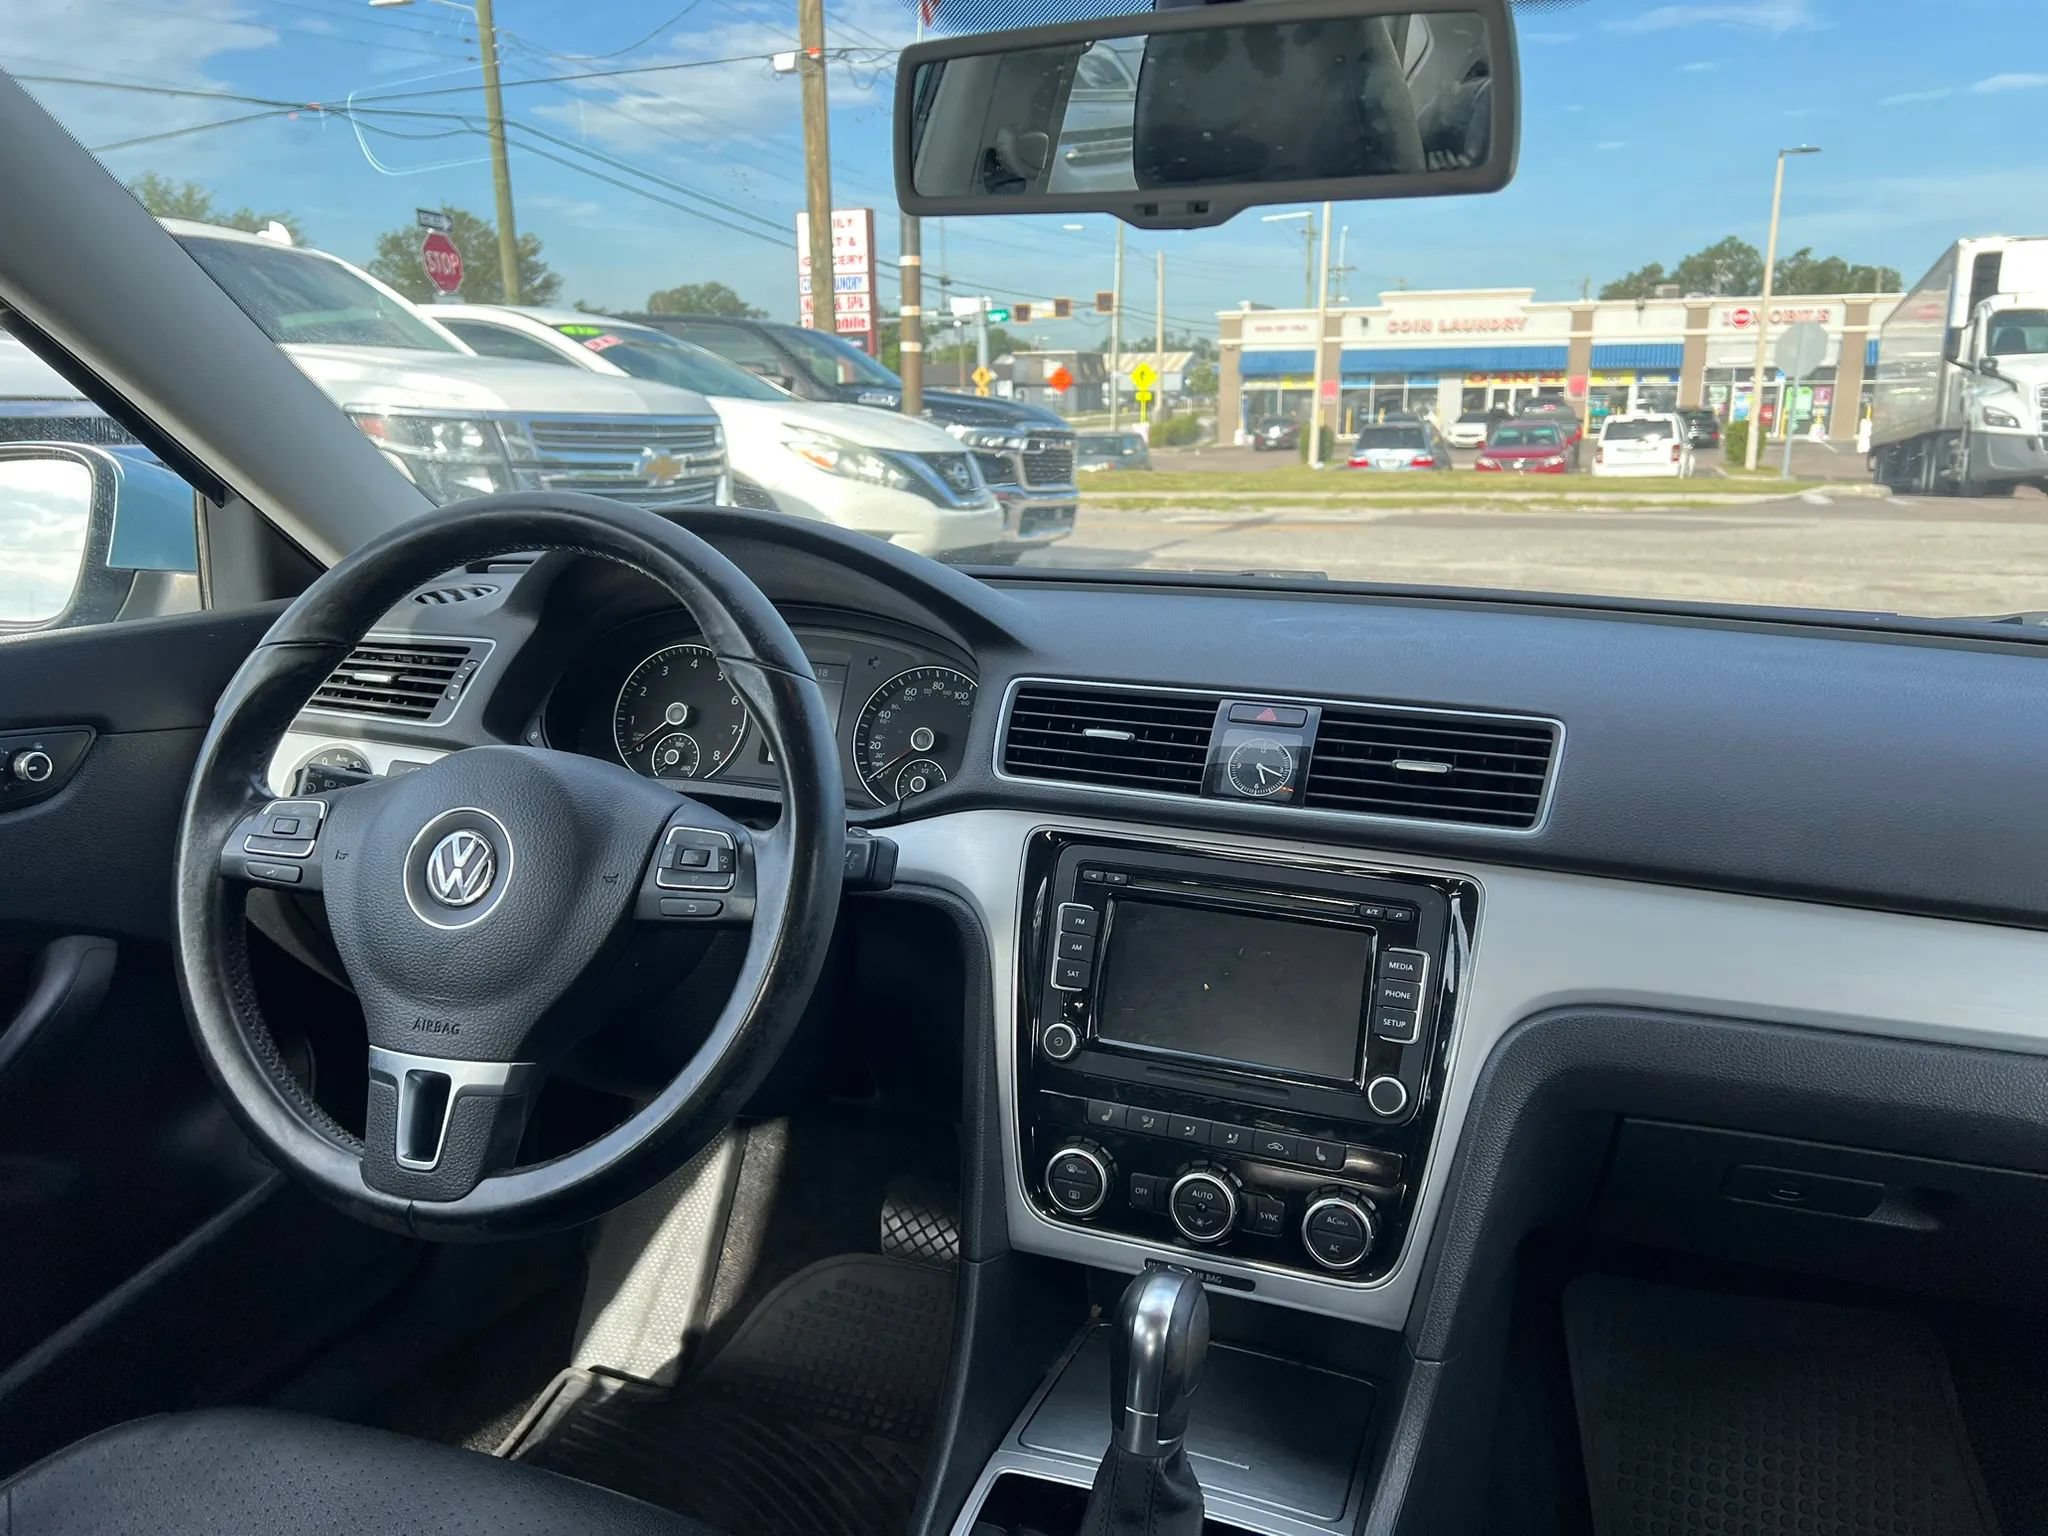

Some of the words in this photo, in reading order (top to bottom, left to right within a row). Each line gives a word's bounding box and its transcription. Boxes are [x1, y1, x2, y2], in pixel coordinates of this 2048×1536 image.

[425, 250, 460, 275] STOP
[1387, 319, 1432, 334] COIN
[1438, 316, 1529, 333] LAUNDRY
[691, 659, 698, 669] 4
[662, 666, 669, 676] 3
[717, 672, 724, 680] 5
[932, 681, 945, 691] 80
[640, 687, 647, 697] 2
[904, 687, 918, 697] 60
[954, 691, 969, 700] 100
[731, 695, 739, 705] 6
[878, 710, 891, 719] 40
[631, 715, 635, 725] 1
[731, 725, 738, 735] 7
[869, 740, 881, 750] 20
[713, 750, 720, 760] 8
[1388, 961, 1414, 972] MEDIA
[1066, 969, 1080, 977] SAT
[1384, 989, 1412, 1000] PHONE
[411, 1017, 461, 1035] AIRBAG
[1383, 1018, 1406, 1028] SETUP
[1135, 1187, 1148, 1195] OFF
[1191, 1190, 1214, 1200] AUTO
[1259, 1212, 1279, 1222] SYNC
[1326, 1216, 1337, 1225] AC
[1329, 1244, 1340, 1252] AC
[1206, 1273, 1222, 1284] BAG
